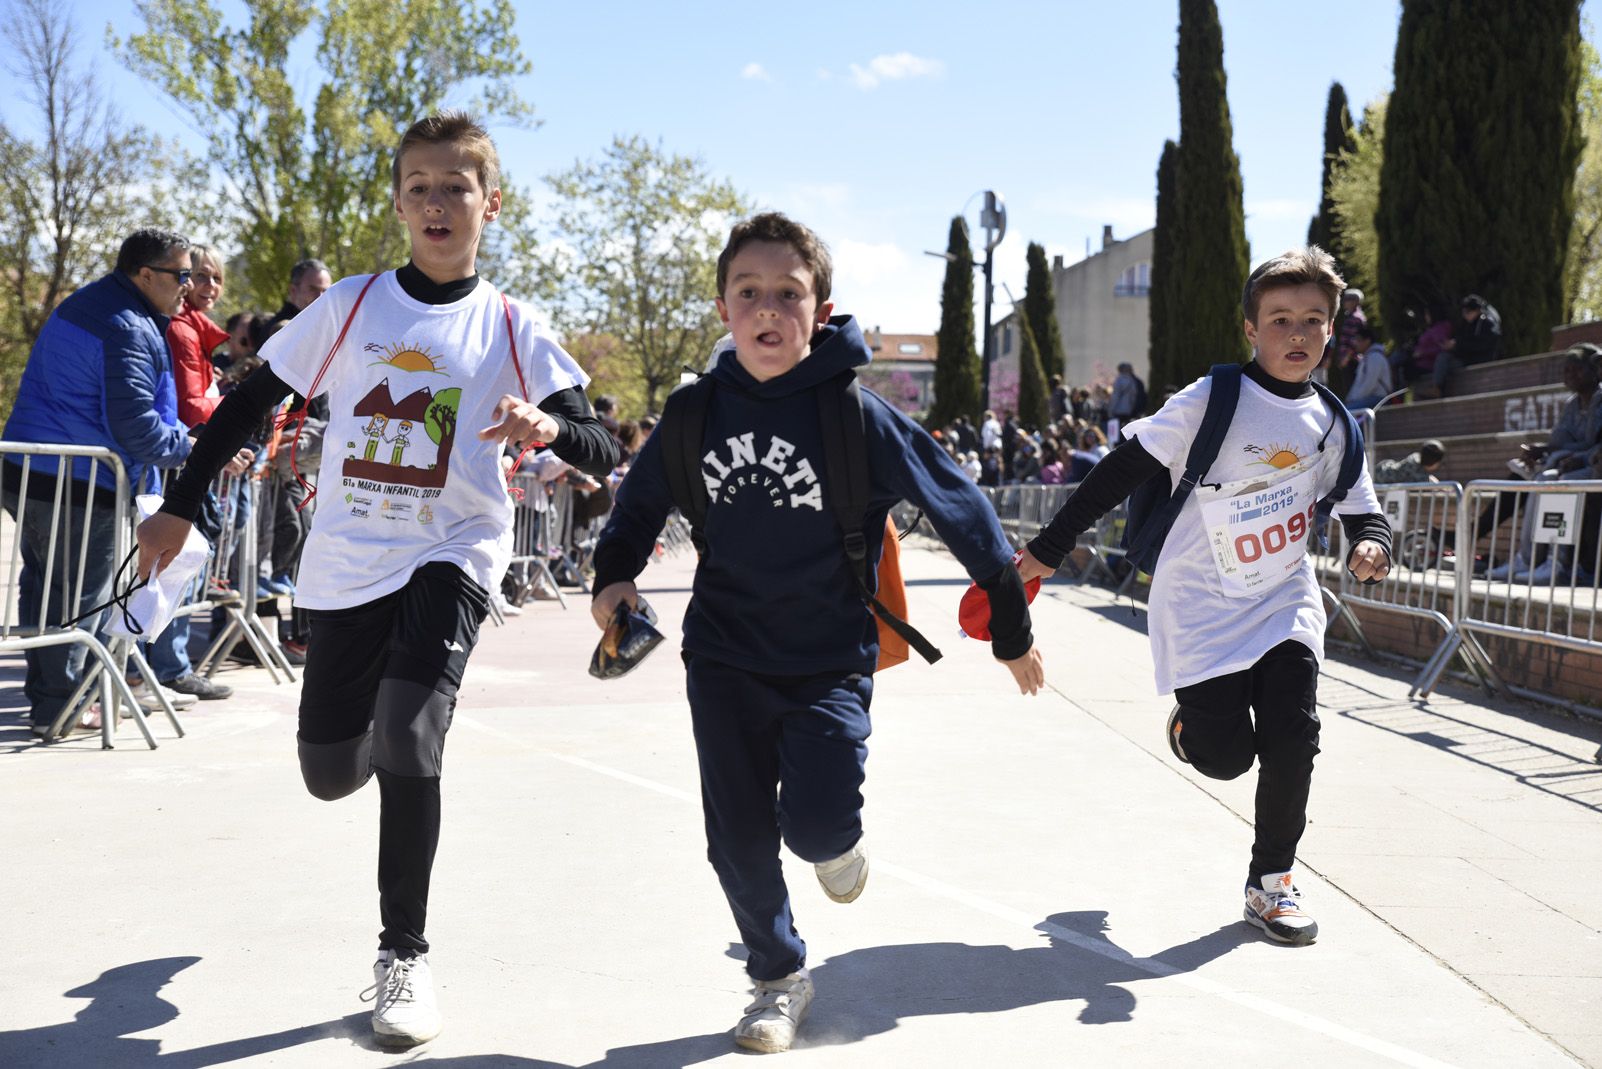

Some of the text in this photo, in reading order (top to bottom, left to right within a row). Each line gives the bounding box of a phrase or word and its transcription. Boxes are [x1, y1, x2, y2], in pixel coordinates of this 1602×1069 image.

[357, 480, 382, 493] MARXA
[382, 485, 420, 498] INFANTIL
[421, 489, 441, 499] 2019
[723, 473, 784, 508] FOREVER
[1255, 486, 1293, 505] Marxa
